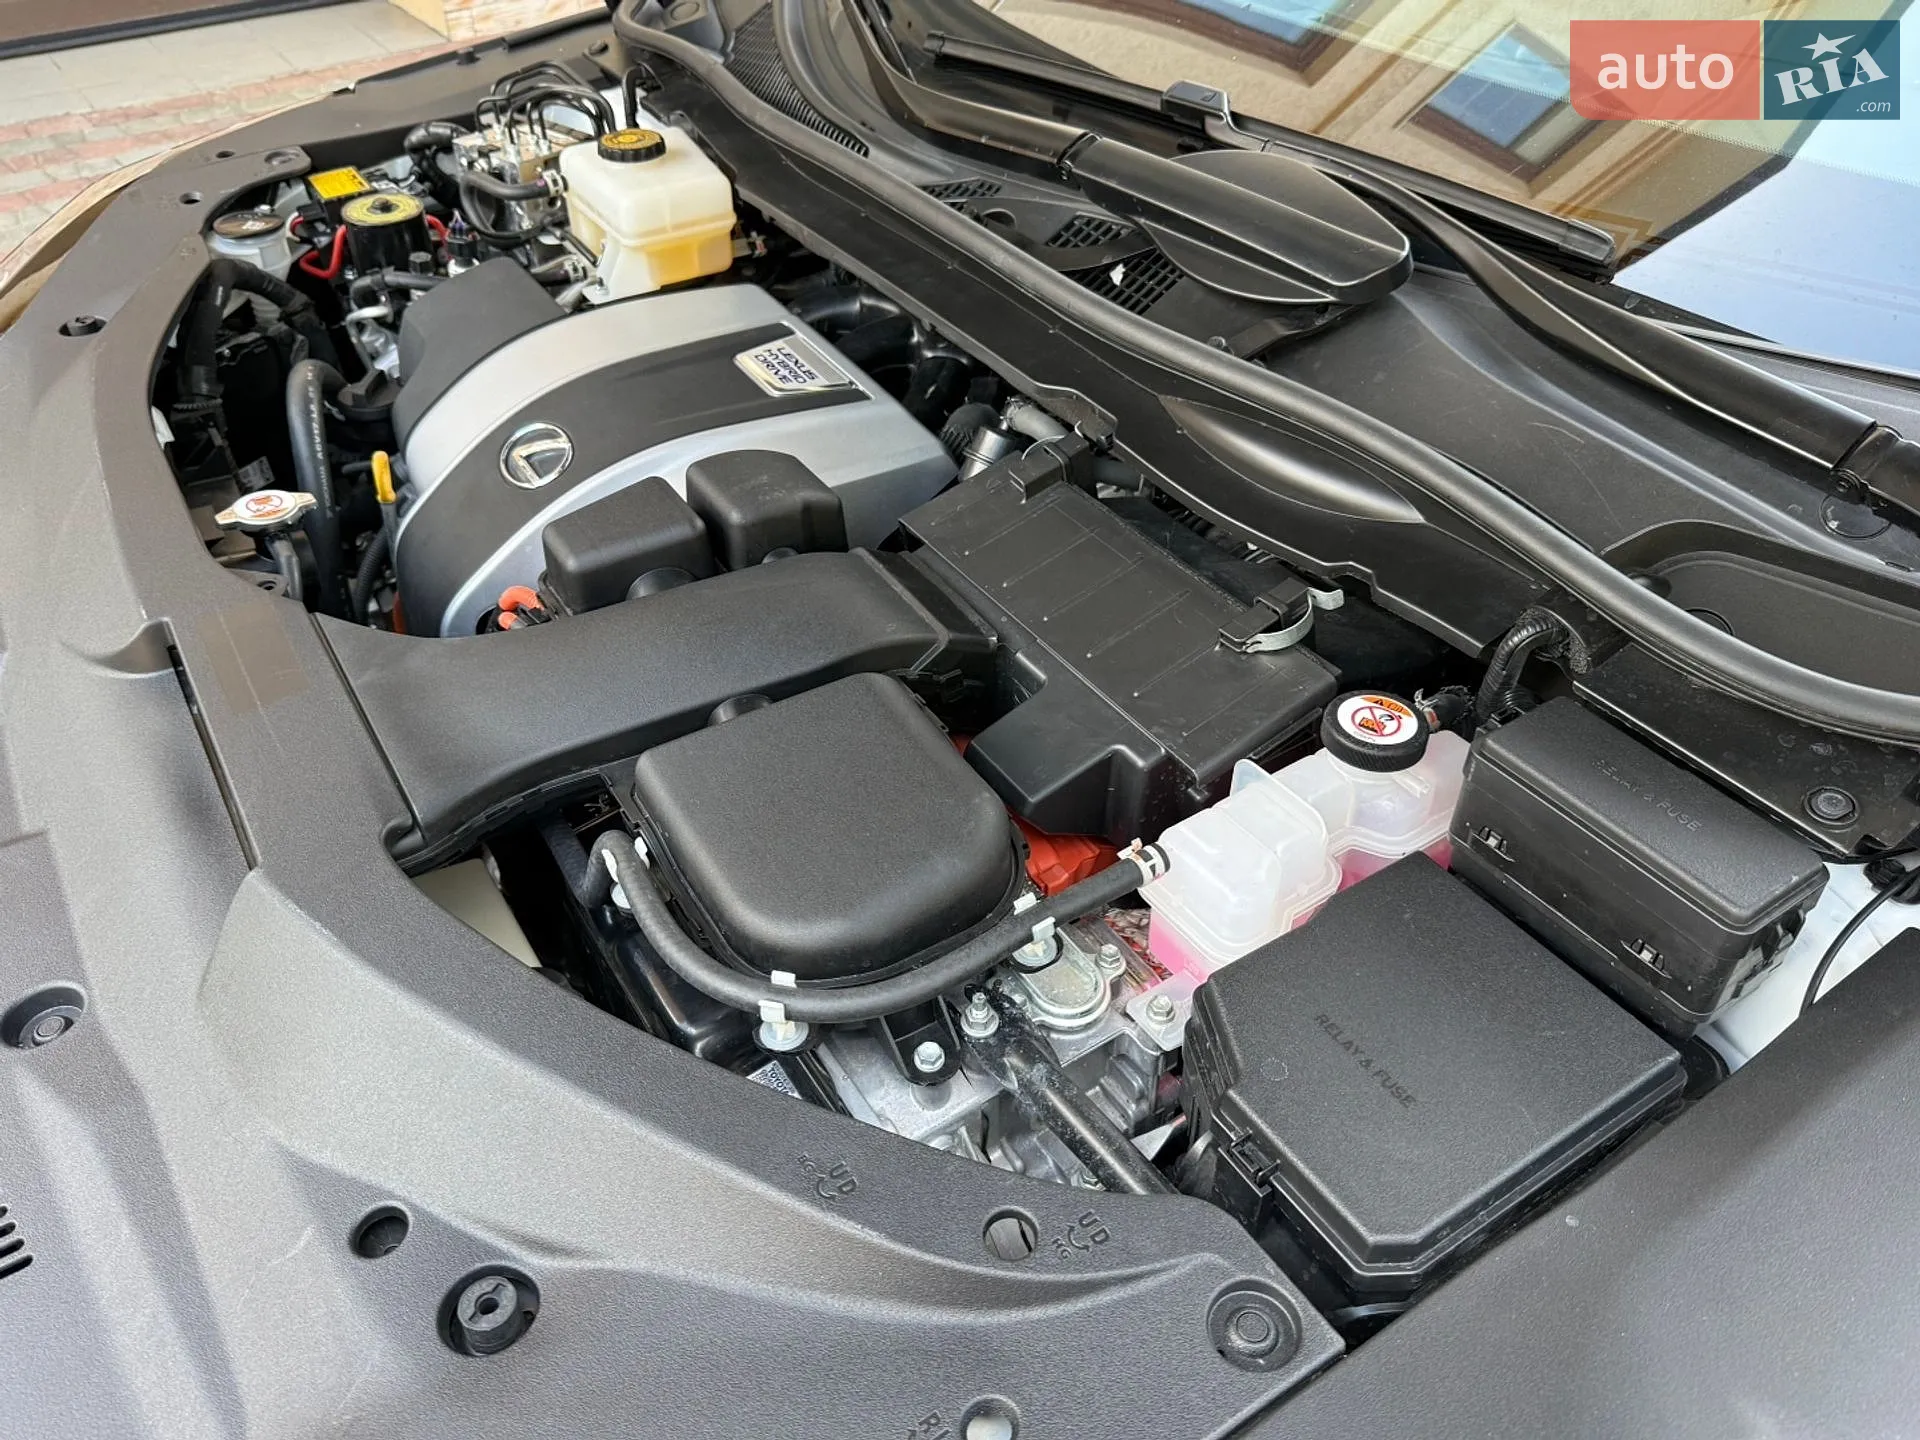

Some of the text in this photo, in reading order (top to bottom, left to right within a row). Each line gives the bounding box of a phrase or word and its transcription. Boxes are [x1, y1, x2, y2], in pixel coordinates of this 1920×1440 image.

[754, 354, 793, 384] DRIVE
[763, 349, 807, 384] HYBRID
[776, 346, 818, 380] LEXUS
[1656, 799, 1702, 832] FUSE
[1314, 1014, 1365, 1056] RELAY
[1371, 1069, 1417, 1109] FUSE
[829, 1160, 859, 1195] UD
[1078, 1209, 1112, 1246] UD
